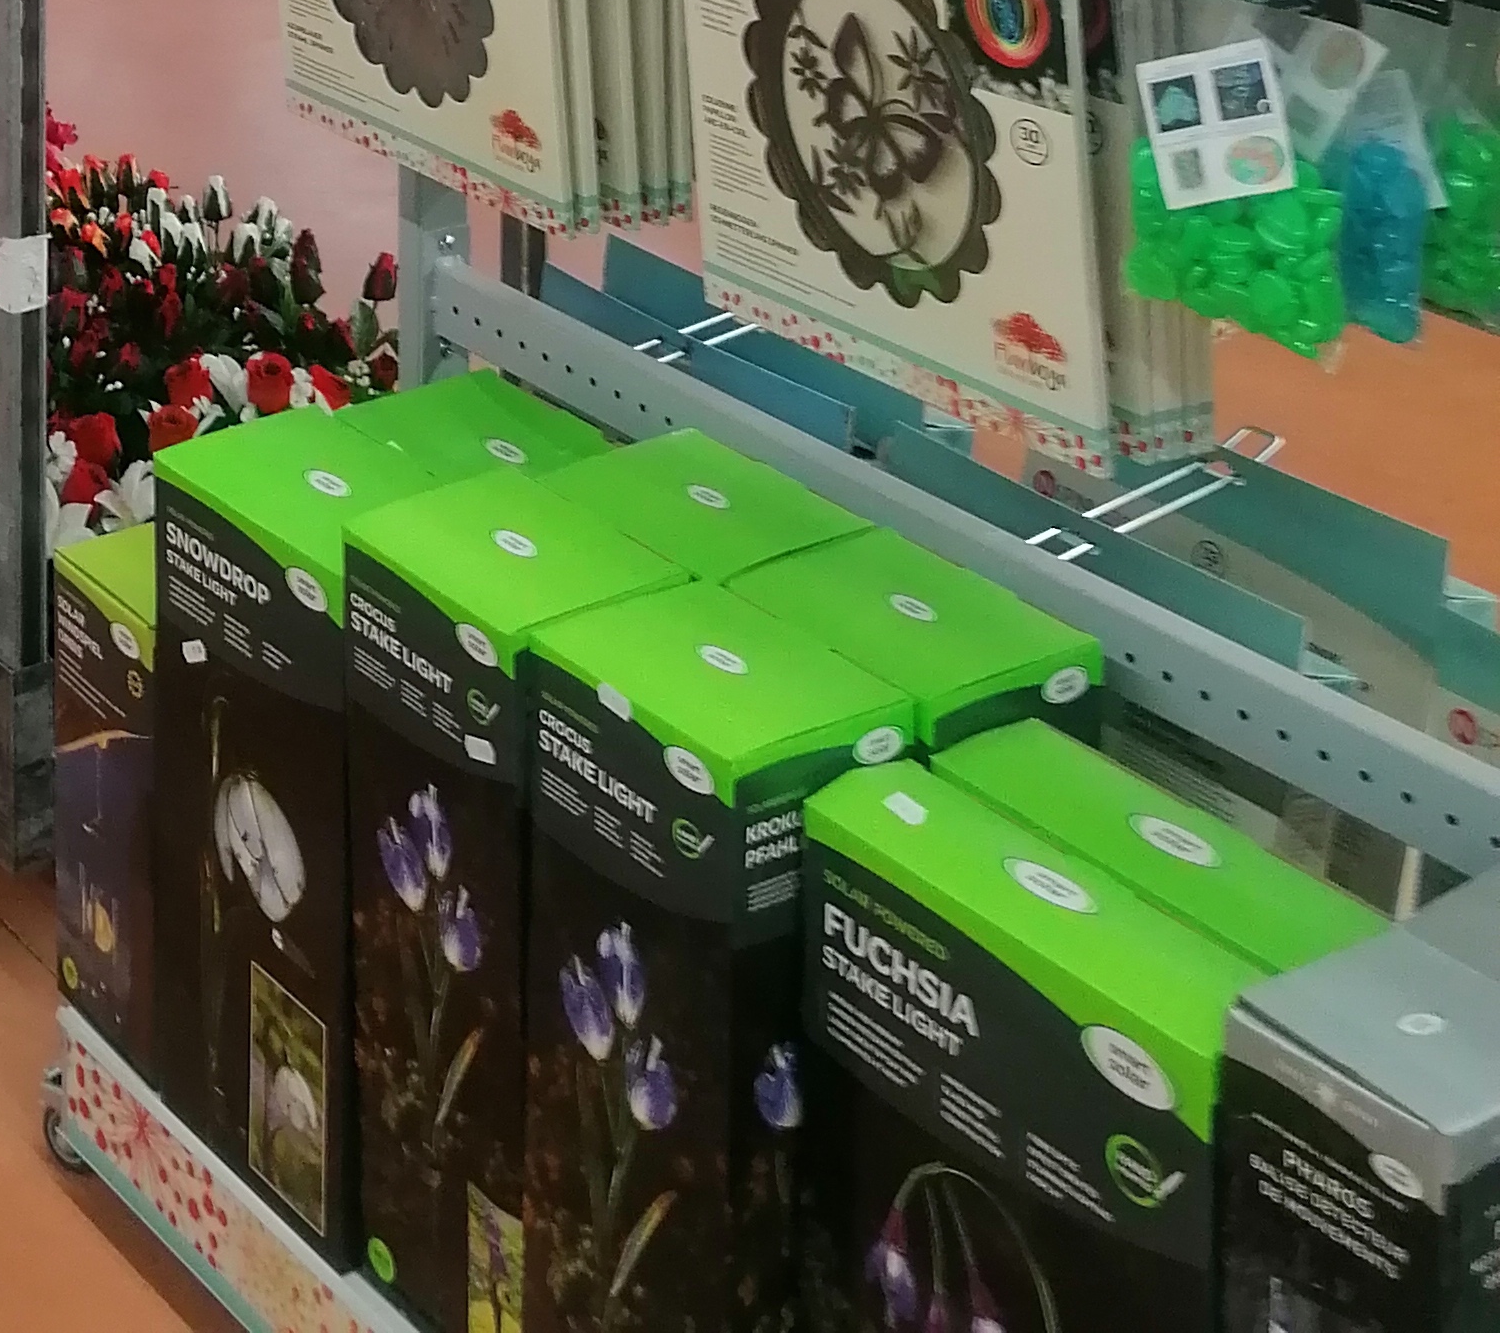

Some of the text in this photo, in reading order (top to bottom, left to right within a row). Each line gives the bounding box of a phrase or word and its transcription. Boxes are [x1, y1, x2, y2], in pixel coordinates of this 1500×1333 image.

[165, 521, 272, 605] SNOWDROP
[165, 548, 239, 606] STAKE LIGHT
[349, 592, 398, 633] CROCUS
[350, 610, 403, 660] STAKE
[401, 646, 454, 694] LIGHT
[538, 708, 594, 755] CROCUS
[537, 728, 659, 824] STAKE LIGHT
[744, 835, 800, 870] PFAHL
[745, 809, 802, 846] KROKU
[823, 901, 981, 1039] FUCHSIA
[821, 943, 965, 1057] STAKE LIGHT
[1107, 1057, 1151, 1090] solar
